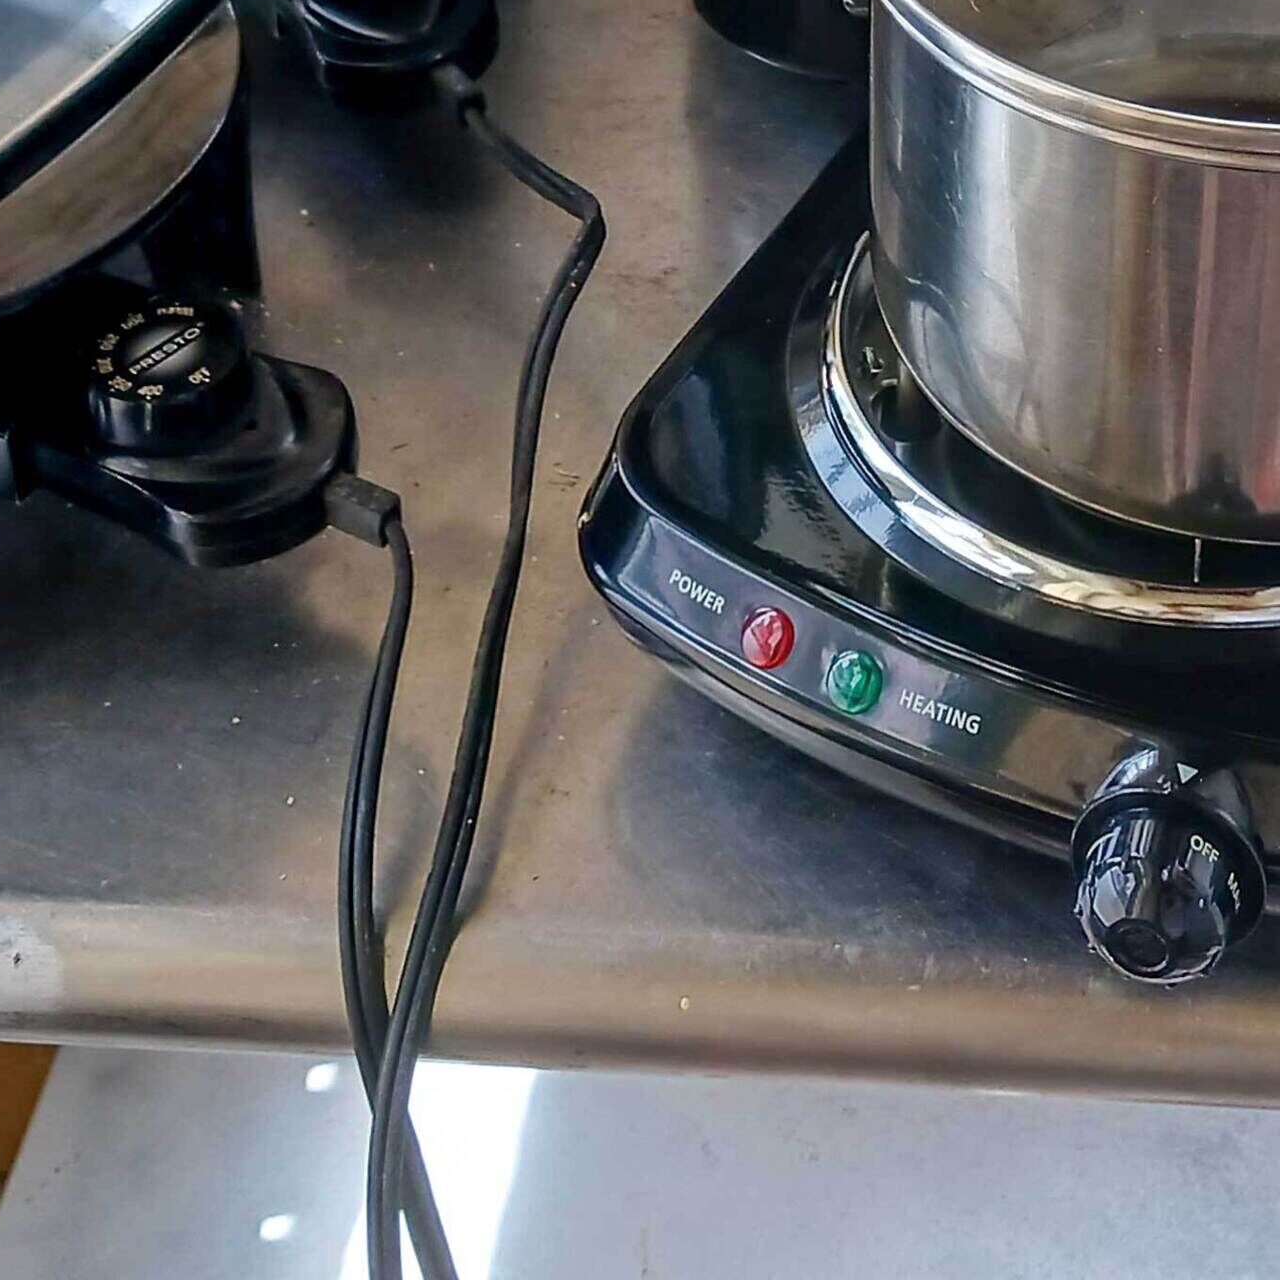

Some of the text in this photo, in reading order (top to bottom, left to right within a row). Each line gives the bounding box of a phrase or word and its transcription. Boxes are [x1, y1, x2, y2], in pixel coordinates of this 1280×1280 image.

[128, 326, 202, 376] PRESTO
[668, 568, 725, 614] POWER
[899, 688, 983, 735] HEATING
[1190, 834, 1220, 864] OFF
